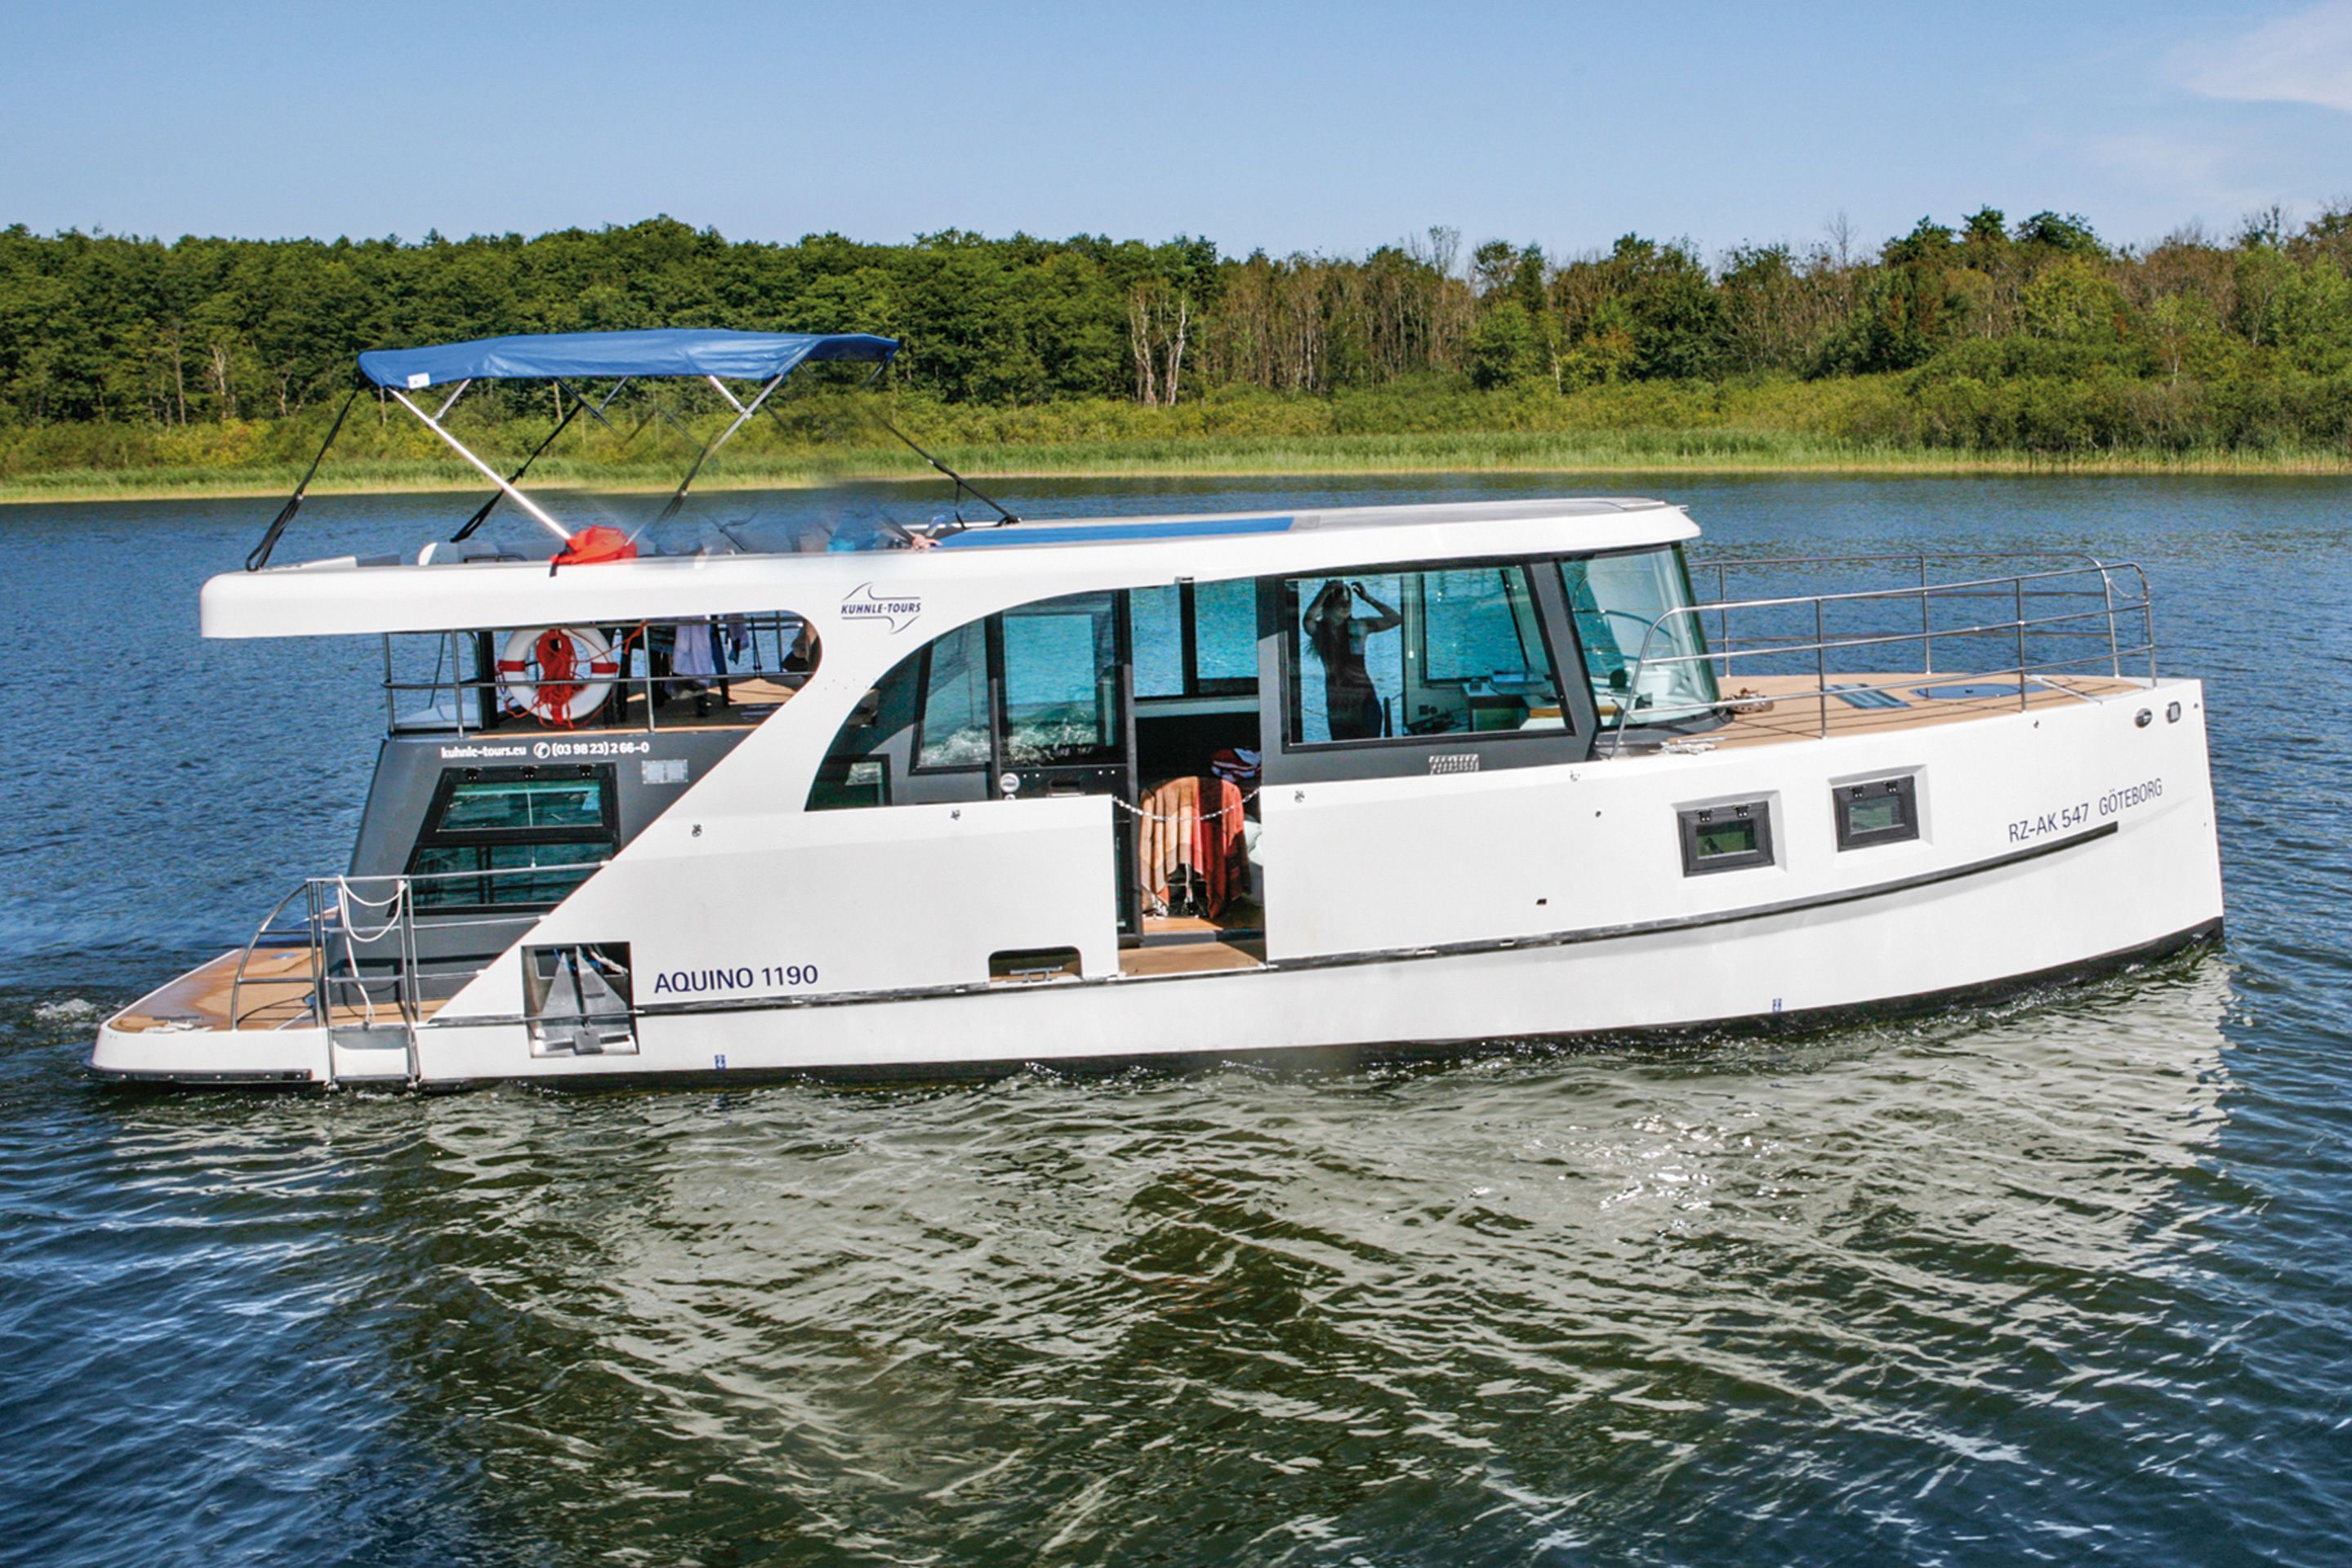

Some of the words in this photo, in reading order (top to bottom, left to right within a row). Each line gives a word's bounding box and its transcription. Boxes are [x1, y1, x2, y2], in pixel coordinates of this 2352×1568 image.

[840, 603, 921, 615] KUHNLE-TOURS
[441, 746, 527, 759] kuhnle-tours.eu
[552, 744, 571, 756] (03
[572, 744, 588, 755] 98
[590, 742, 609, 755] 23)
[2008, 812, 2057, 843] RZ-AK
[2062, 803, 2089, 828] 547
[2099, 777, 2163, 816] GÖTEBORG
[654, 967, 754, 994] AQUINO
[761, 964, 818, 987] 1190
